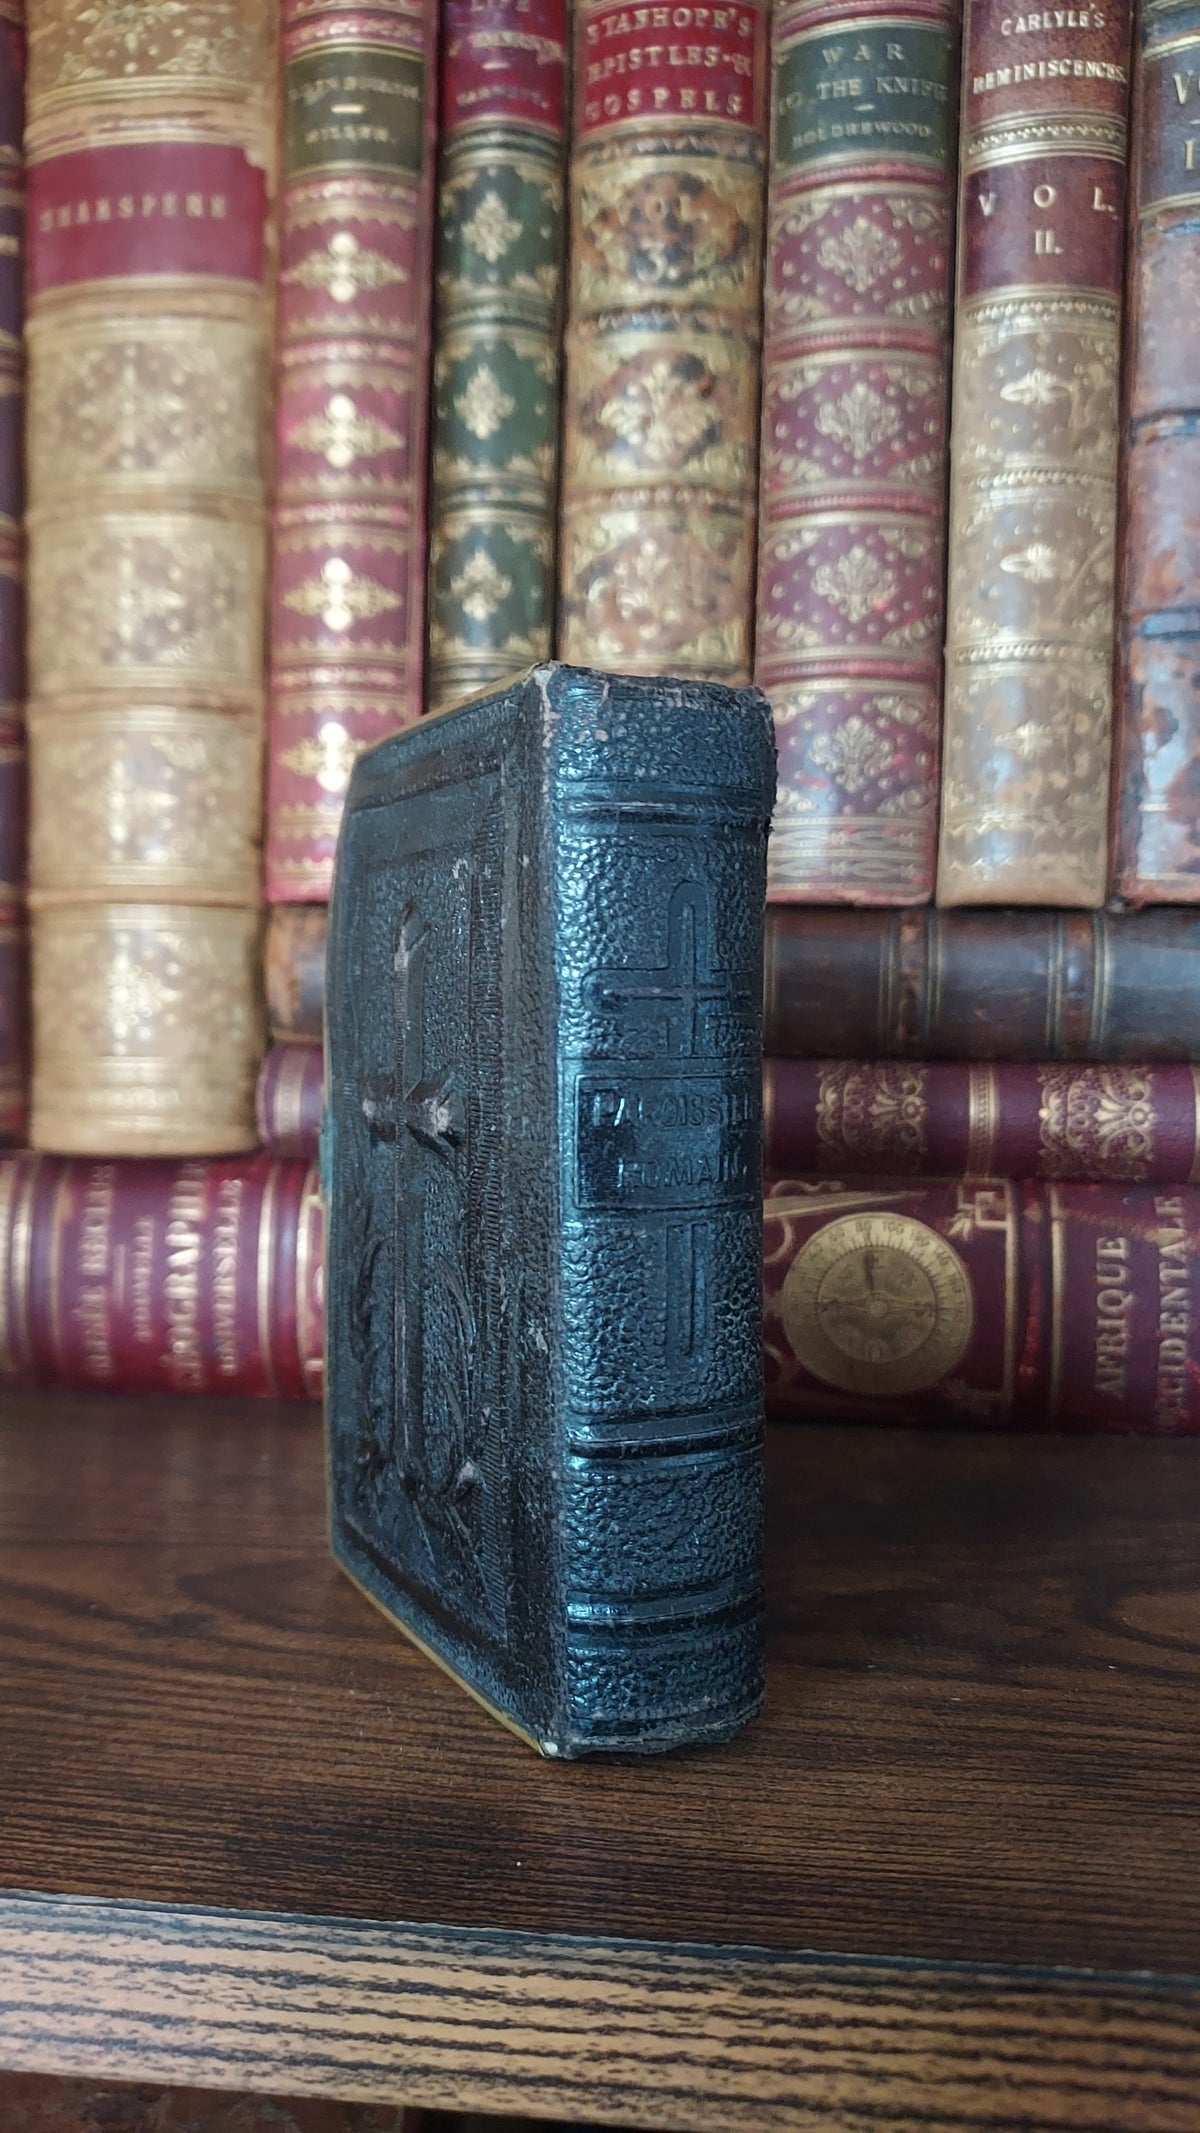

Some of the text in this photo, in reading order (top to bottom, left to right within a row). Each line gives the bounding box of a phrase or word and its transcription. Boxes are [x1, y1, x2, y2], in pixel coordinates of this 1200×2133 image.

[587, 7, 751, 44] STANHOPE'S
[1001, 3, 1105, 36] CARLYLE'S
[822, 43, 905, 64] WAR
[816, 79, 863, 100] THE
[875, 76, 948, 99] KNIFE
[973, 59, 1128, 94] REMINISCENCES
[1173, 70, 1200, 105] V
[585, 87, 743, 121] GOSPELS
[40, 191, 228, 232] SHAKSPERE
[979, 184, 1117, 217] VOL.
[1034, 229, 1063, 255] II.
[211, 1178, 244, 1377] UNIVERSELLE
[1095, 1236, 1134, 1400] AFRIQUE
